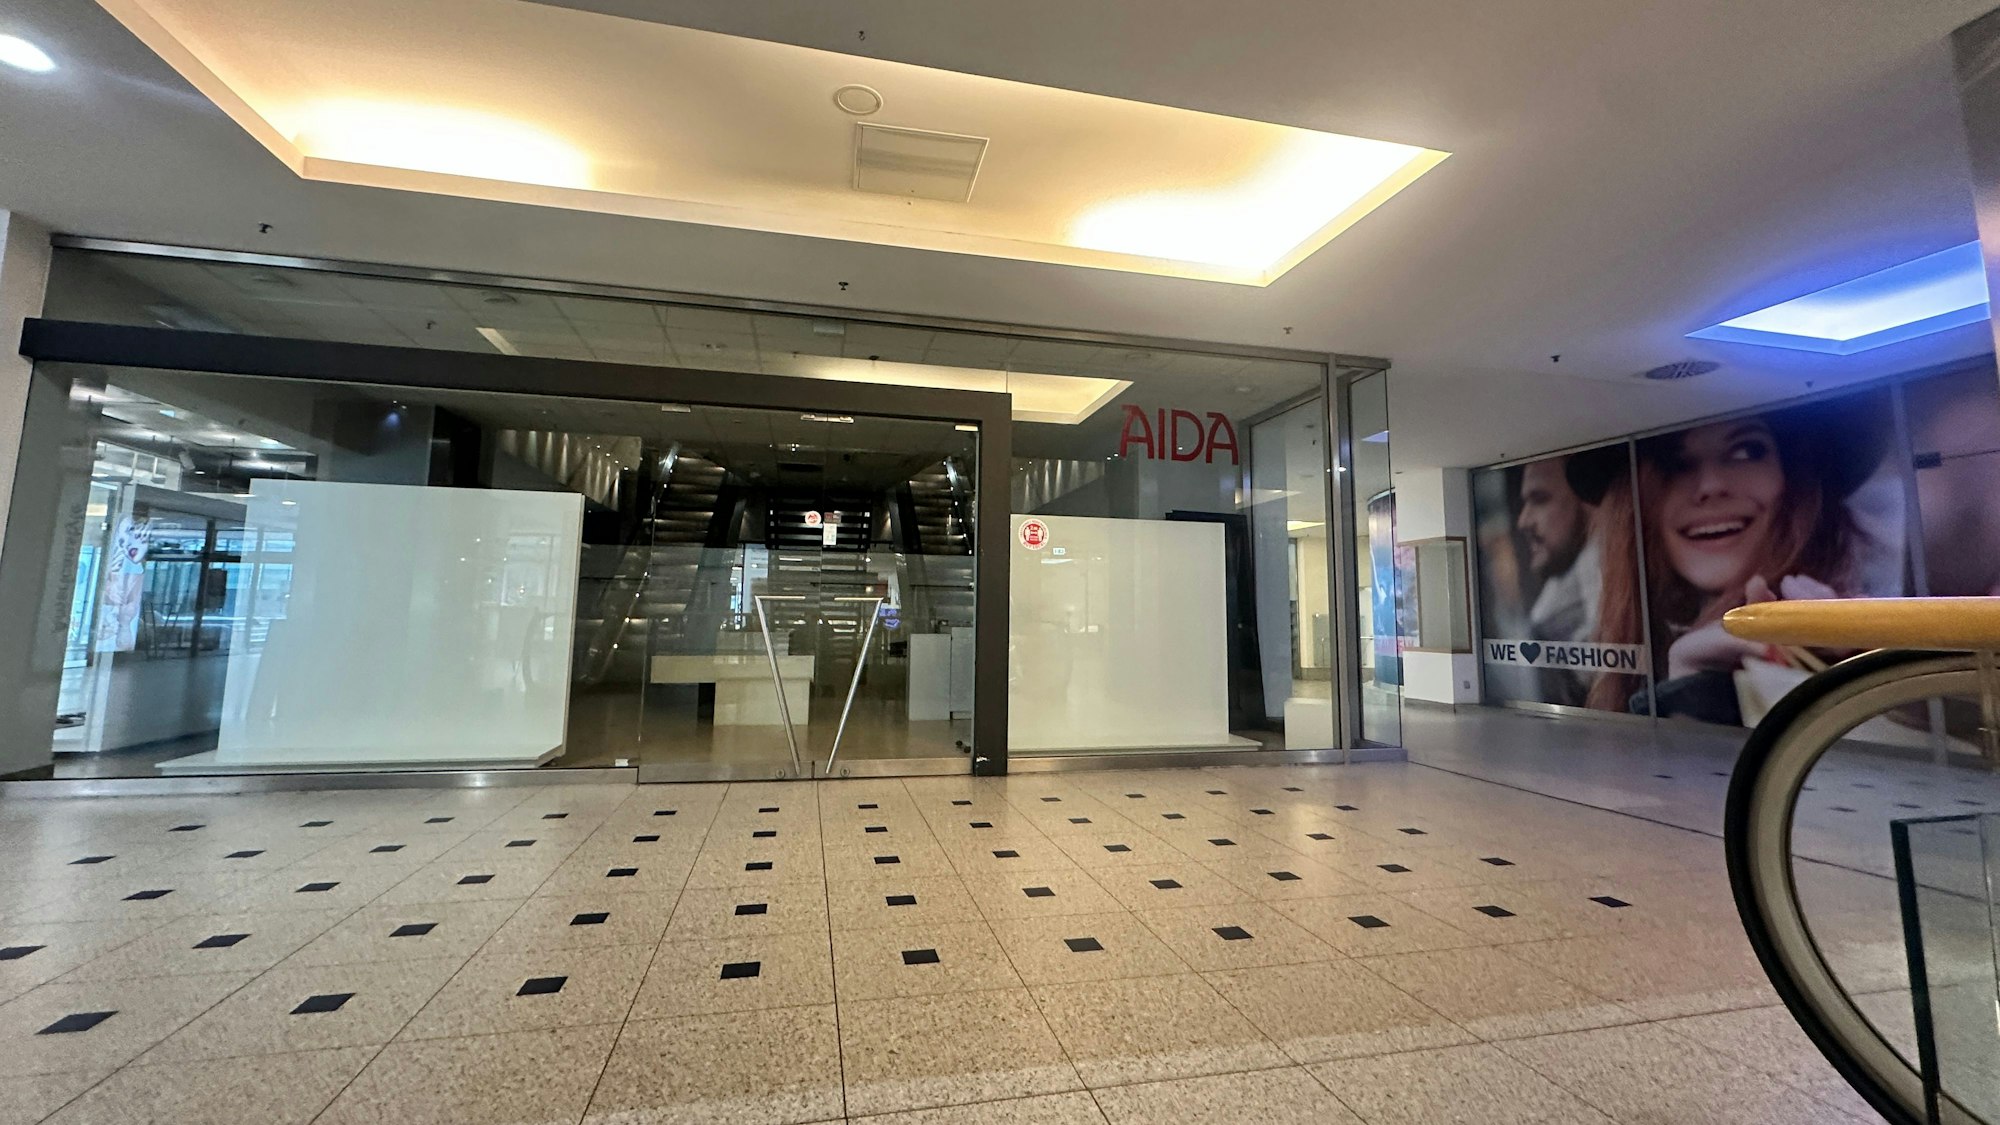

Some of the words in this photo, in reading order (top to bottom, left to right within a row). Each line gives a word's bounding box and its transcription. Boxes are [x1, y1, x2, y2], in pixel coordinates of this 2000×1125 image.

[1120, 404, 1239, 465] AIDA
[1490, 644, 1517, 661] WE
[1545, 646, 1637, 669] FASHION
